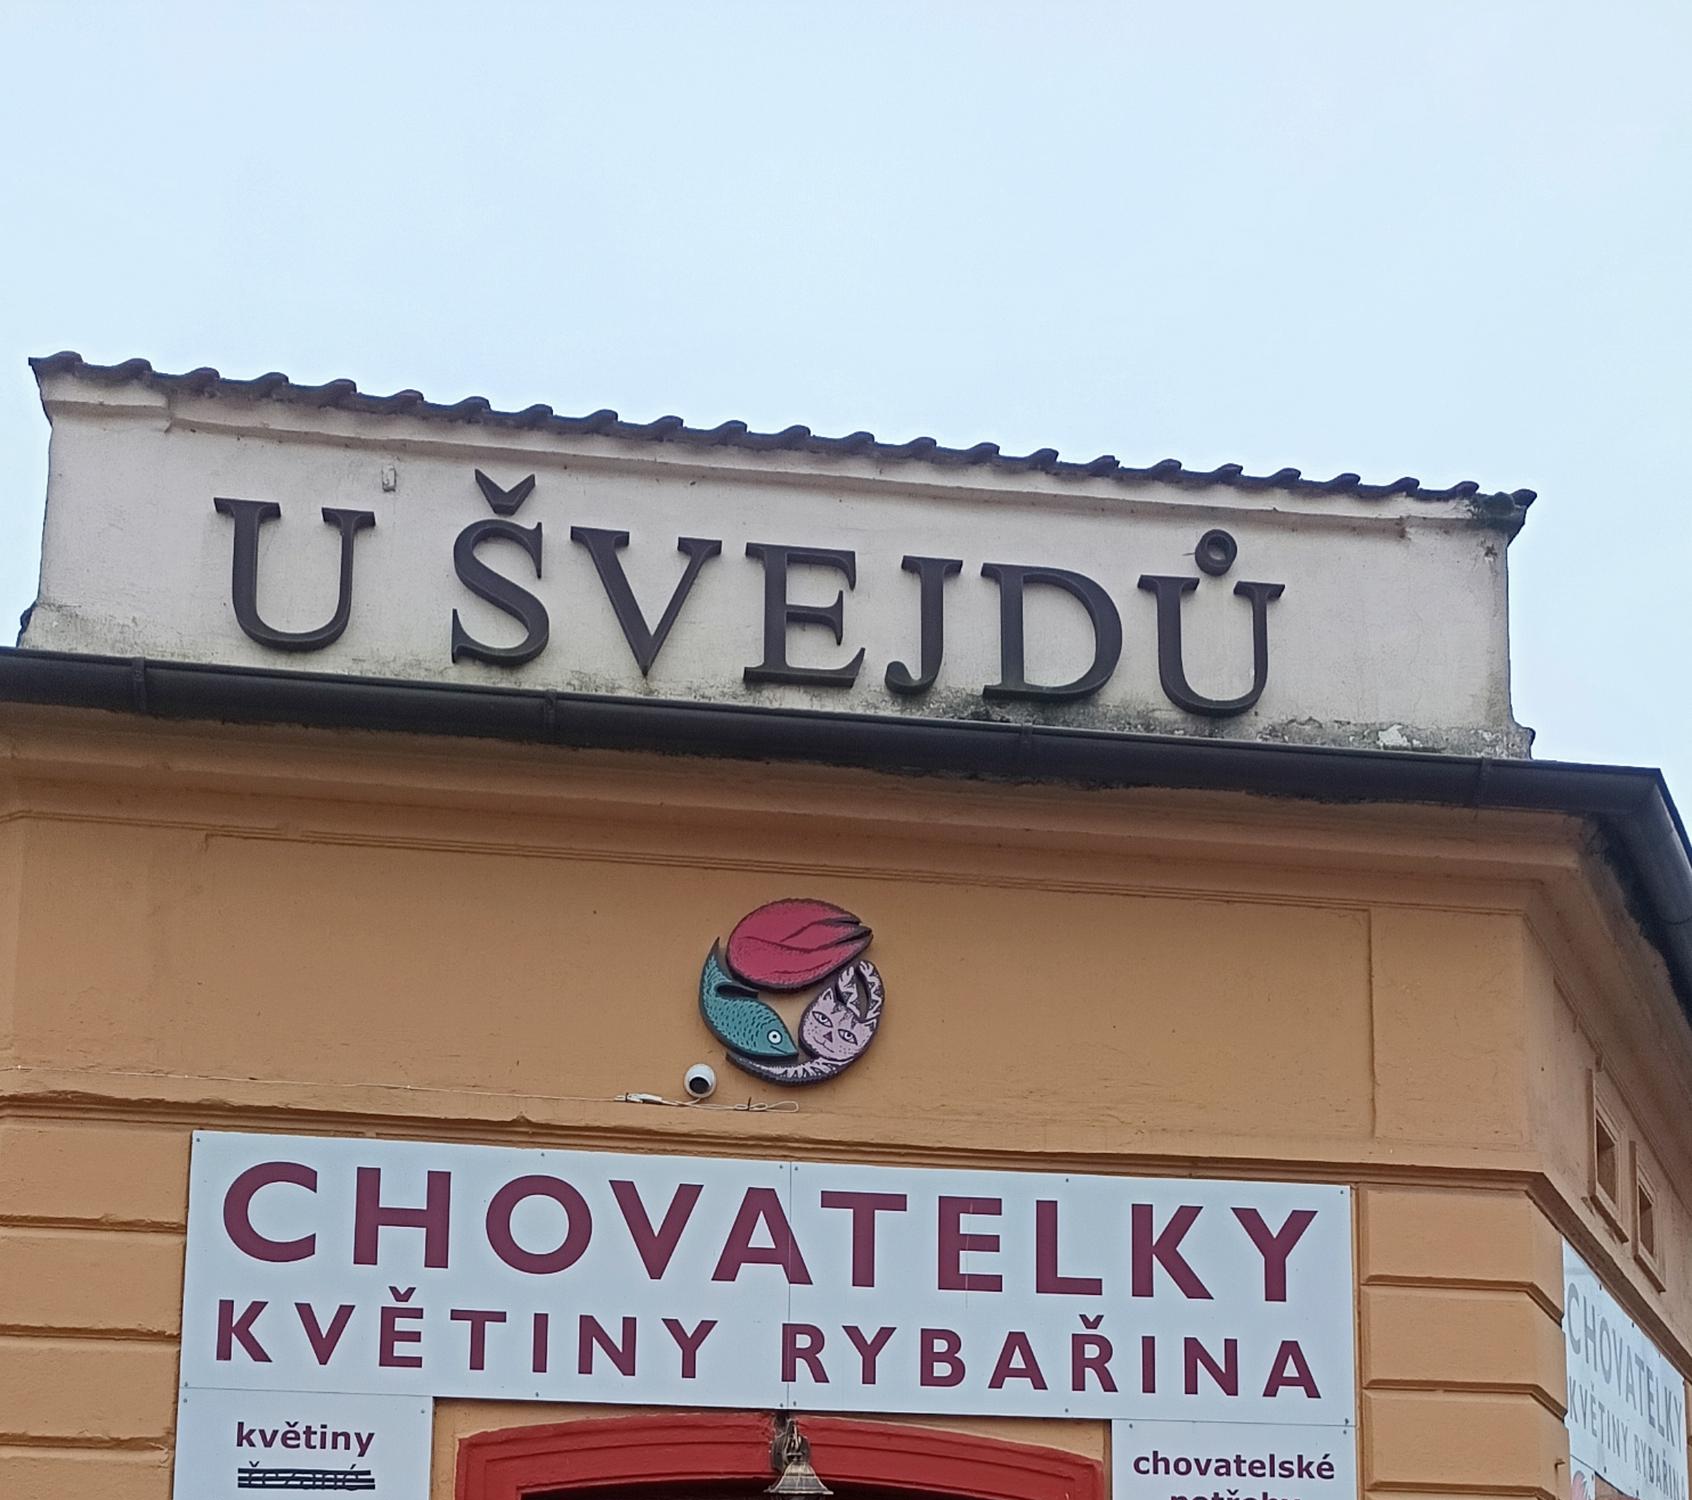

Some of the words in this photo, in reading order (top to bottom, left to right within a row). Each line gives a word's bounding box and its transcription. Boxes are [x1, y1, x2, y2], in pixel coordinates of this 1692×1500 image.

[214, 498, 375, 652] U
[451, 468, 1286, 718] ŠVEJDŮ
[223, 1161, 1319, 1302] CHOVATELKY
[215, 1286, 718, 1379] KVĚTINY
[781, 1314, 1322, 1398] RYBAŘINA
[1567, 1282, 1684, 1453] CHOVATELKY
[237, 1421, 374, 1457] květiny
[1134, 1451, 1334, 1479] chovatelské
[1568, 1375, 1630, 1464] KVĚTINY
